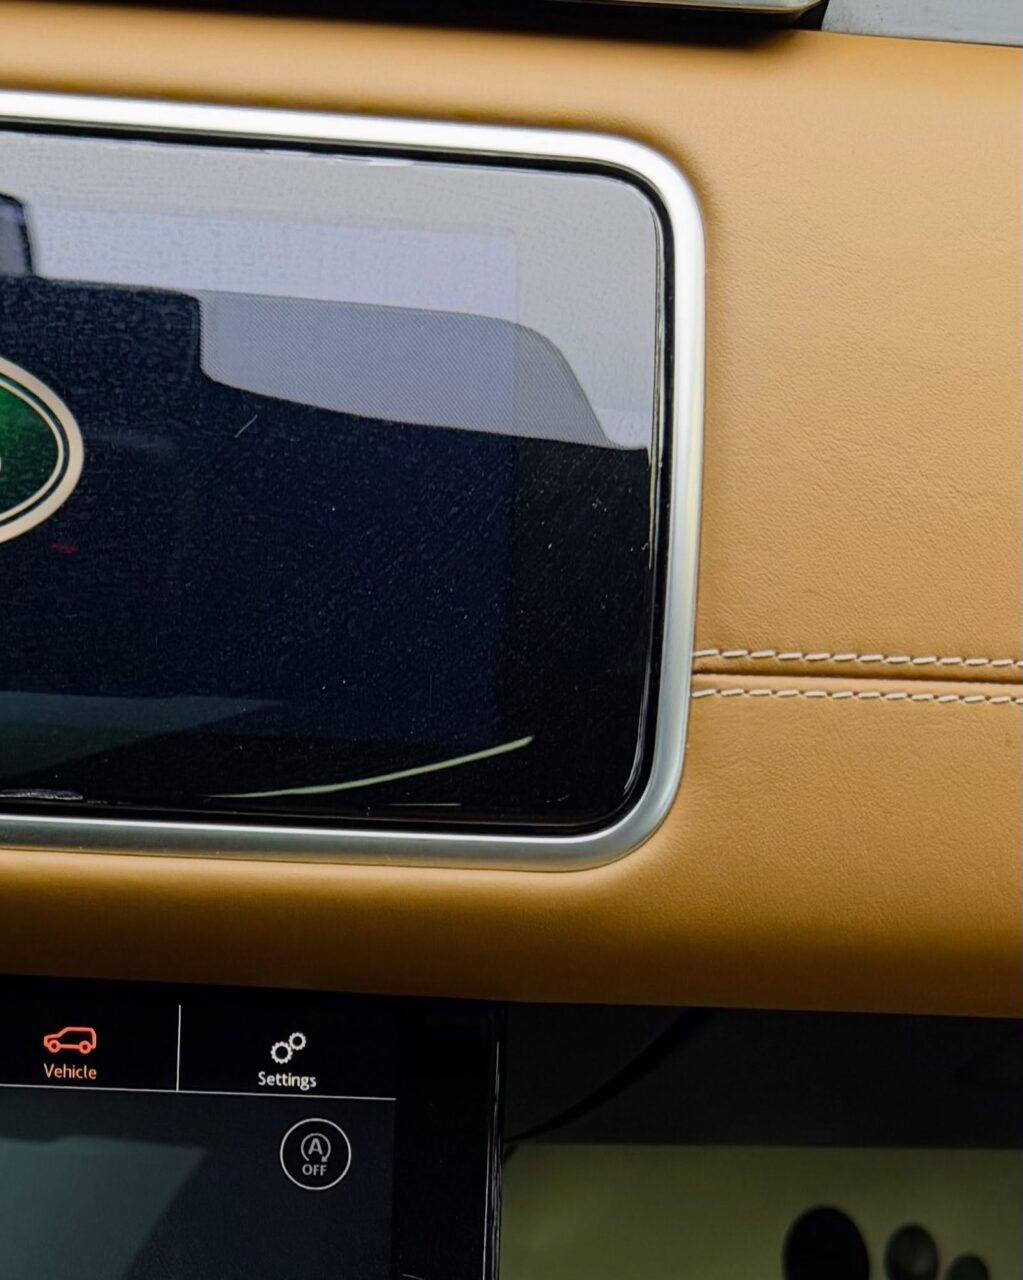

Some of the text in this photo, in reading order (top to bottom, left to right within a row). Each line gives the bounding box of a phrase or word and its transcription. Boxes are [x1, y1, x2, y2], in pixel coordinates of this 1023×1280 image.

[43, 1063, 97, 1080] Vehicle
[258, 1071, 317, 1090] Settings
[302, 1163, 327, 1176] OFF
